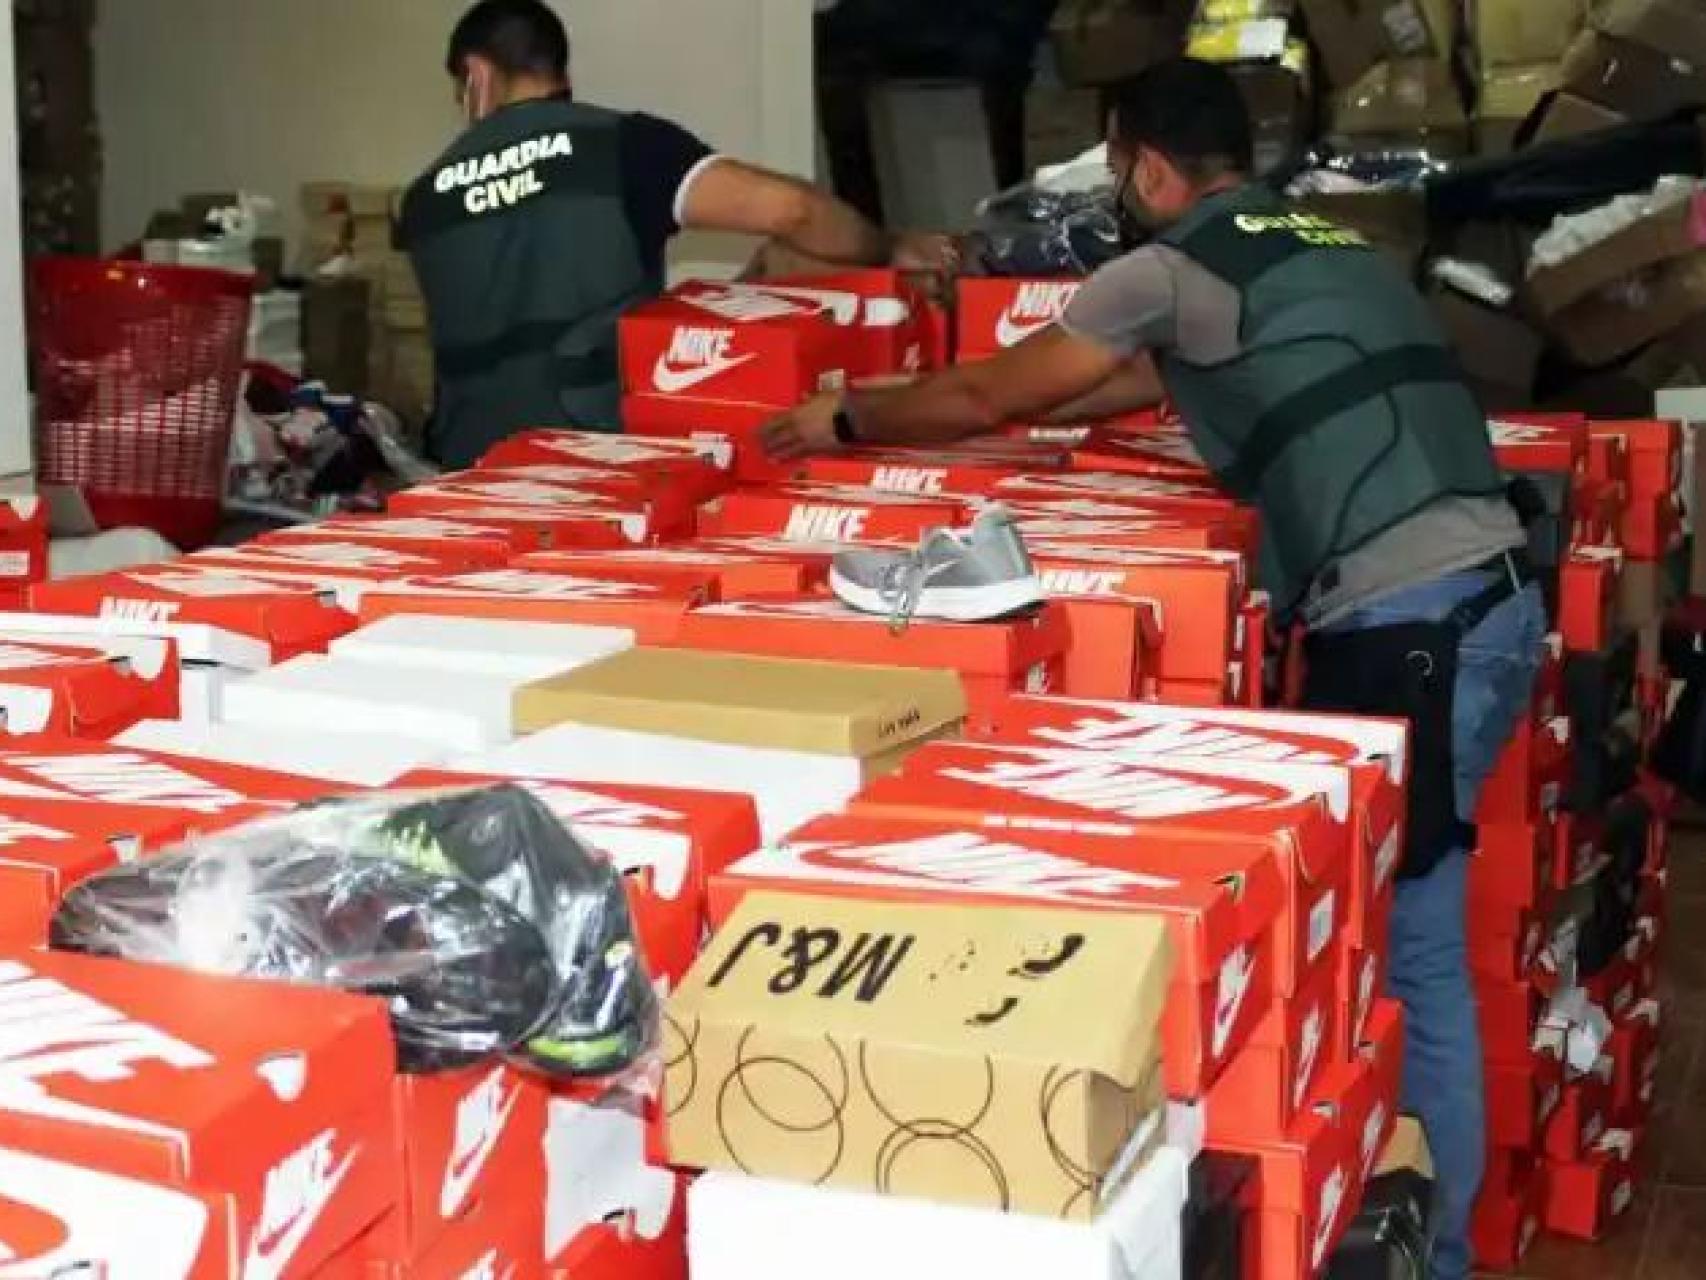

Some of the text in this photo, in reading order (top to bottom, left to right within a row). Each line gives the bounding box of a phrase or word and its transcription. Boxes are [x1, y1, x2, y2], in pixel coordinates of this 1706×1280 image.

[434, 132, 573, 192] GUARDIA
[464, 168, 544, 214] CIVIL
[783, 503, 869, 542] NIKE
[706, 921, 916, 1003] M&J
